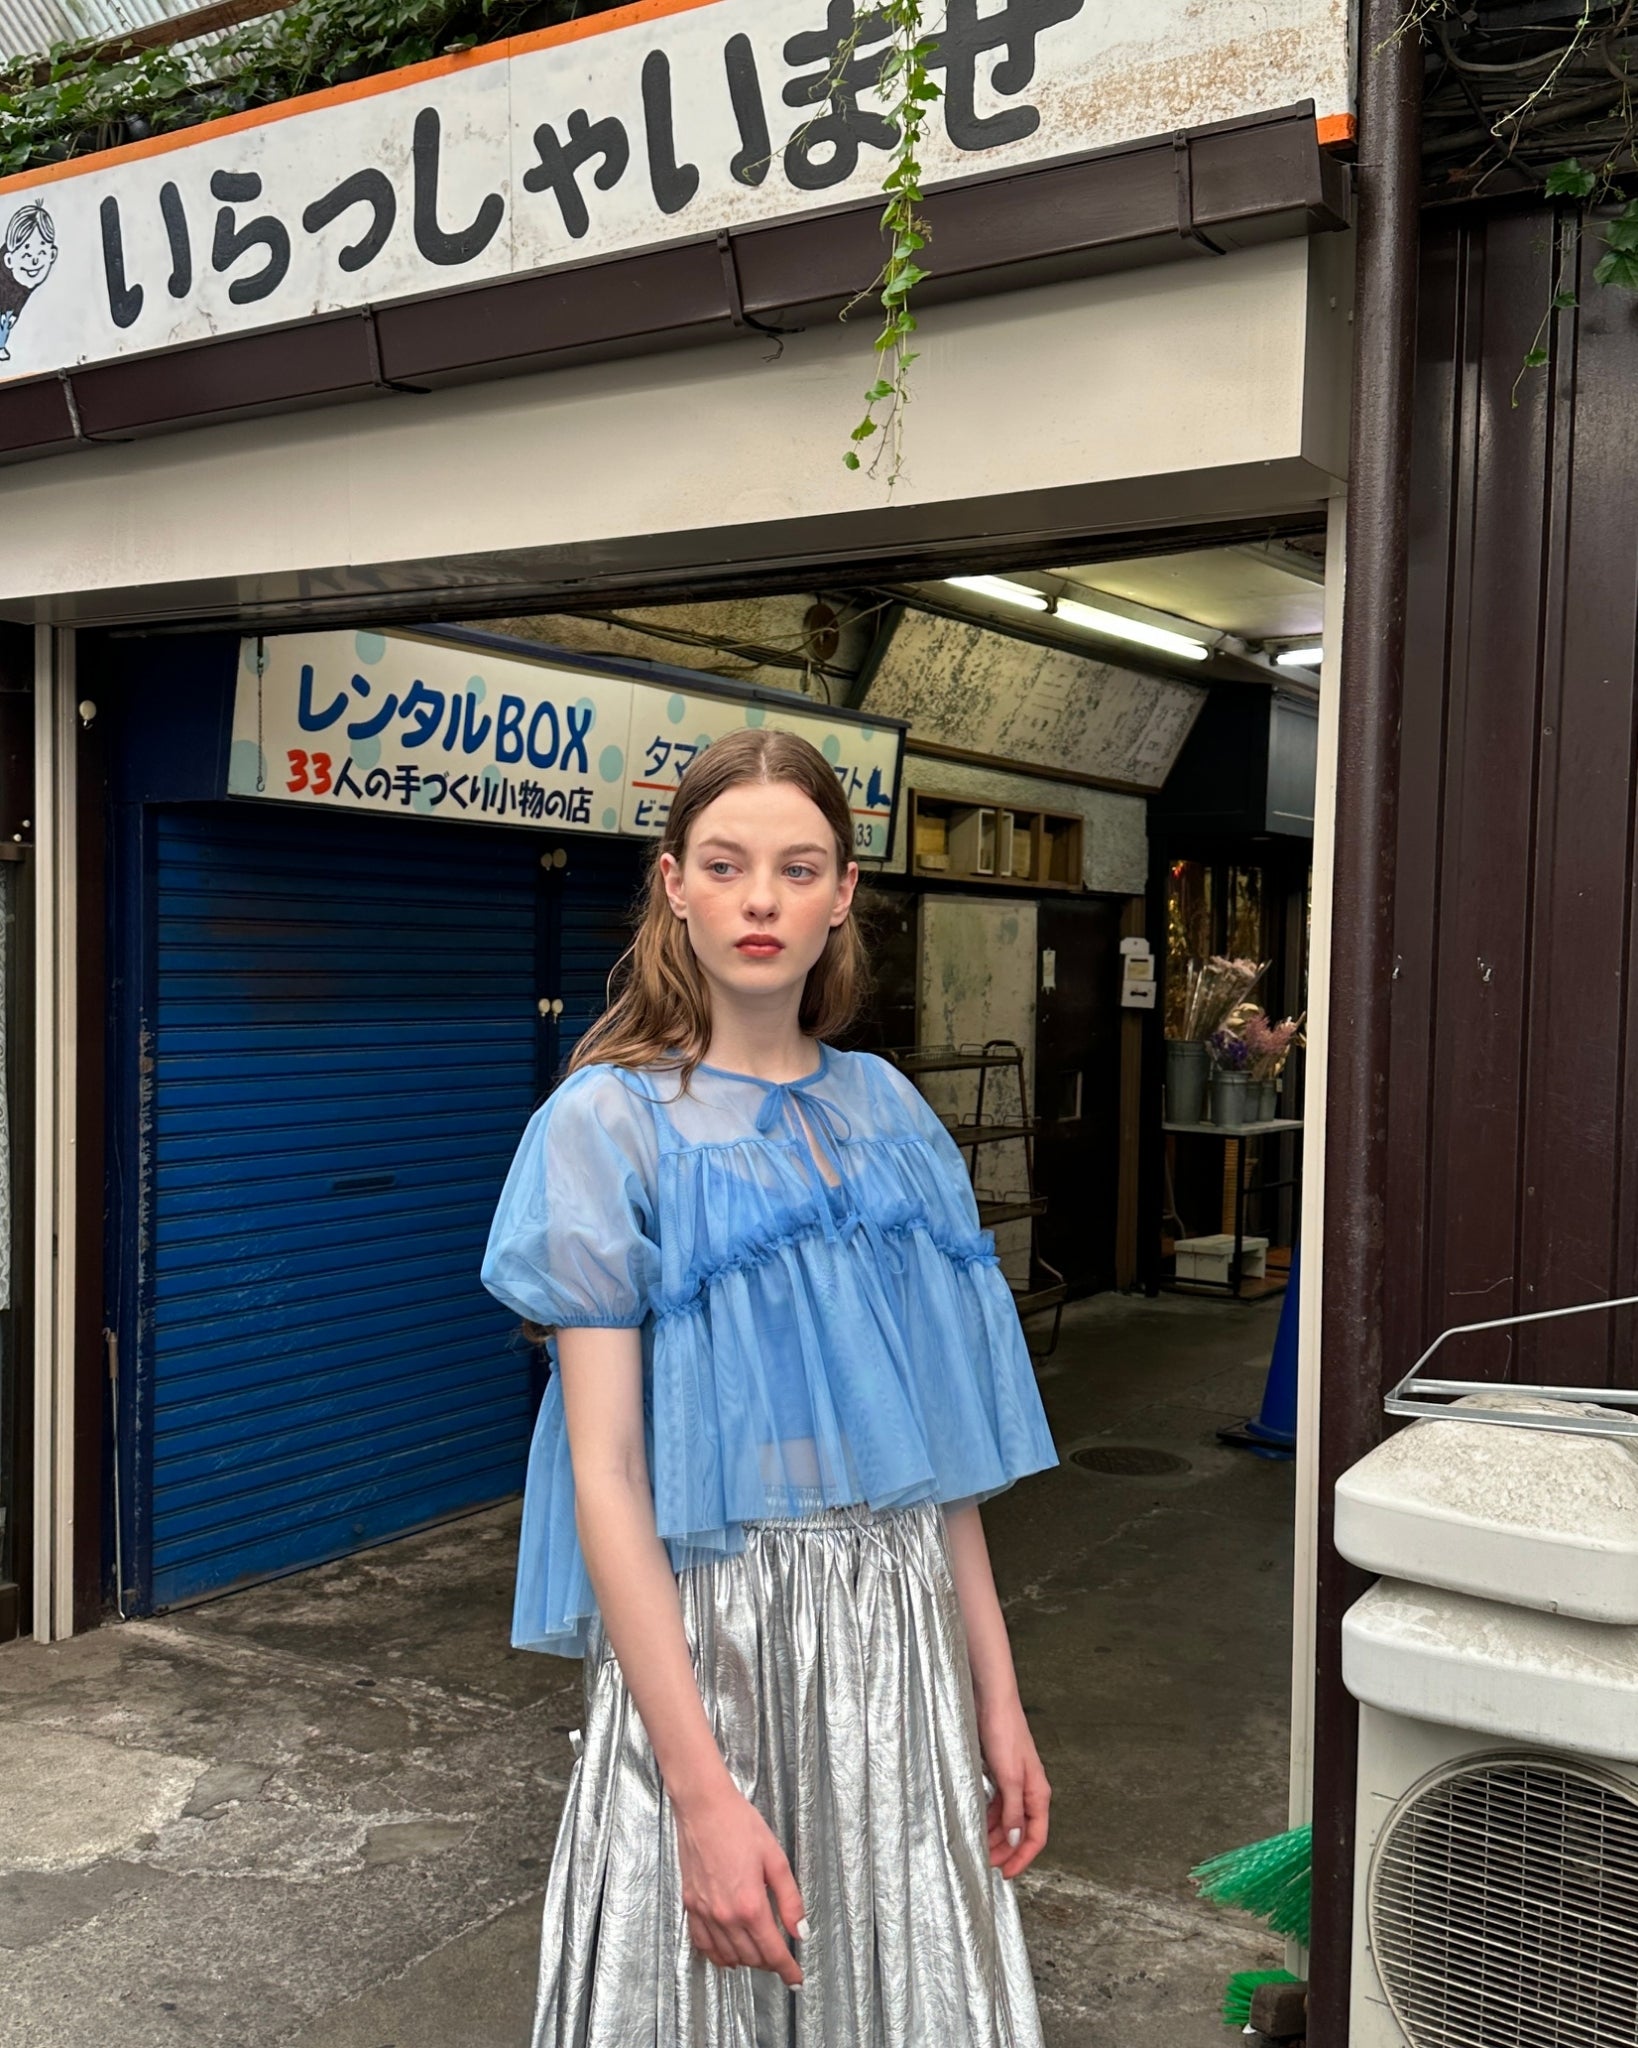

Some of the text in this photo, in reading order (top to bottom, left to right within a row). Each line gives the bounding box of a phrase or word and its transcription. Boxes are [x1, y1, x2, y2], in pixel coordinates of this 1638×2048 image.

[101, 0, 1084, 328] いらっしゃいませ
[644, 735, 709, 778] タマ
